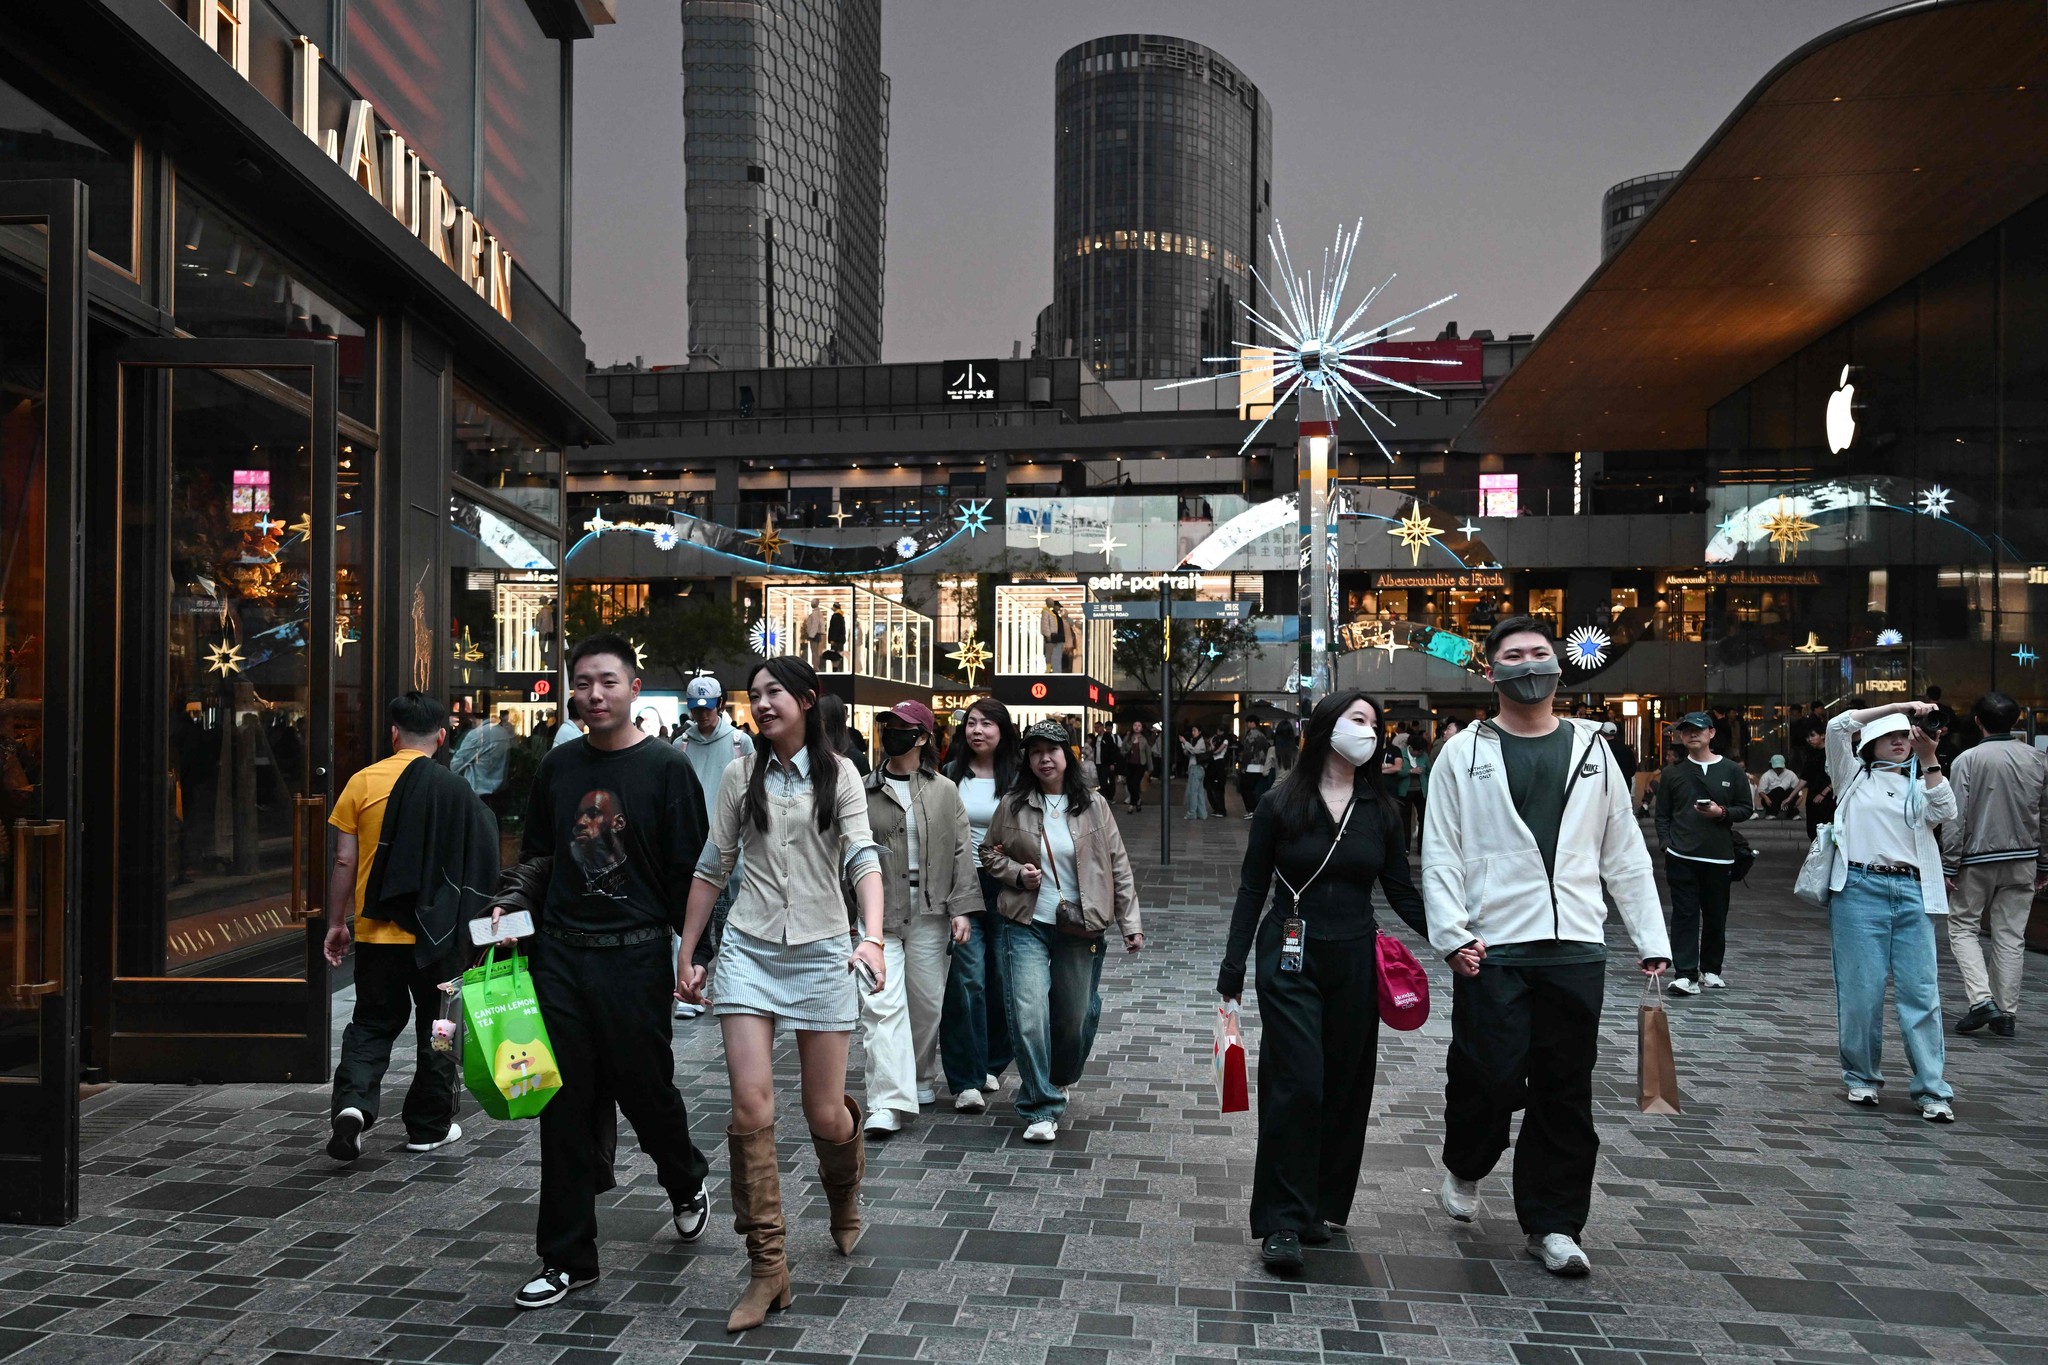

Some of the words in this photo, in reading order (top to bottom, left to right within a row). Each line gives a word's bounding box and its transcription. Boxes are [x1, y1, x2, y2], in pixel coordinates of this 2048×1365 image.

[292, 34, 512, 323] LAUREN
[952, 363, 986, 389] 小
[1088, 573, 1202, 593] self-portrait
[1377, 573, 1456, 586] Abercrombie
[1458, 576, 1469, 585] &
[1472, 573, 1504, 586] Fitch
[1584, 763, 1599, 771] NIKE
[218, 909, 284, 942] RALPH
[474, 1004, 506, 1019] CANTON
[508, 998, 535, 1011] LEMON
[477, 1018, 494, 1027] TEA
